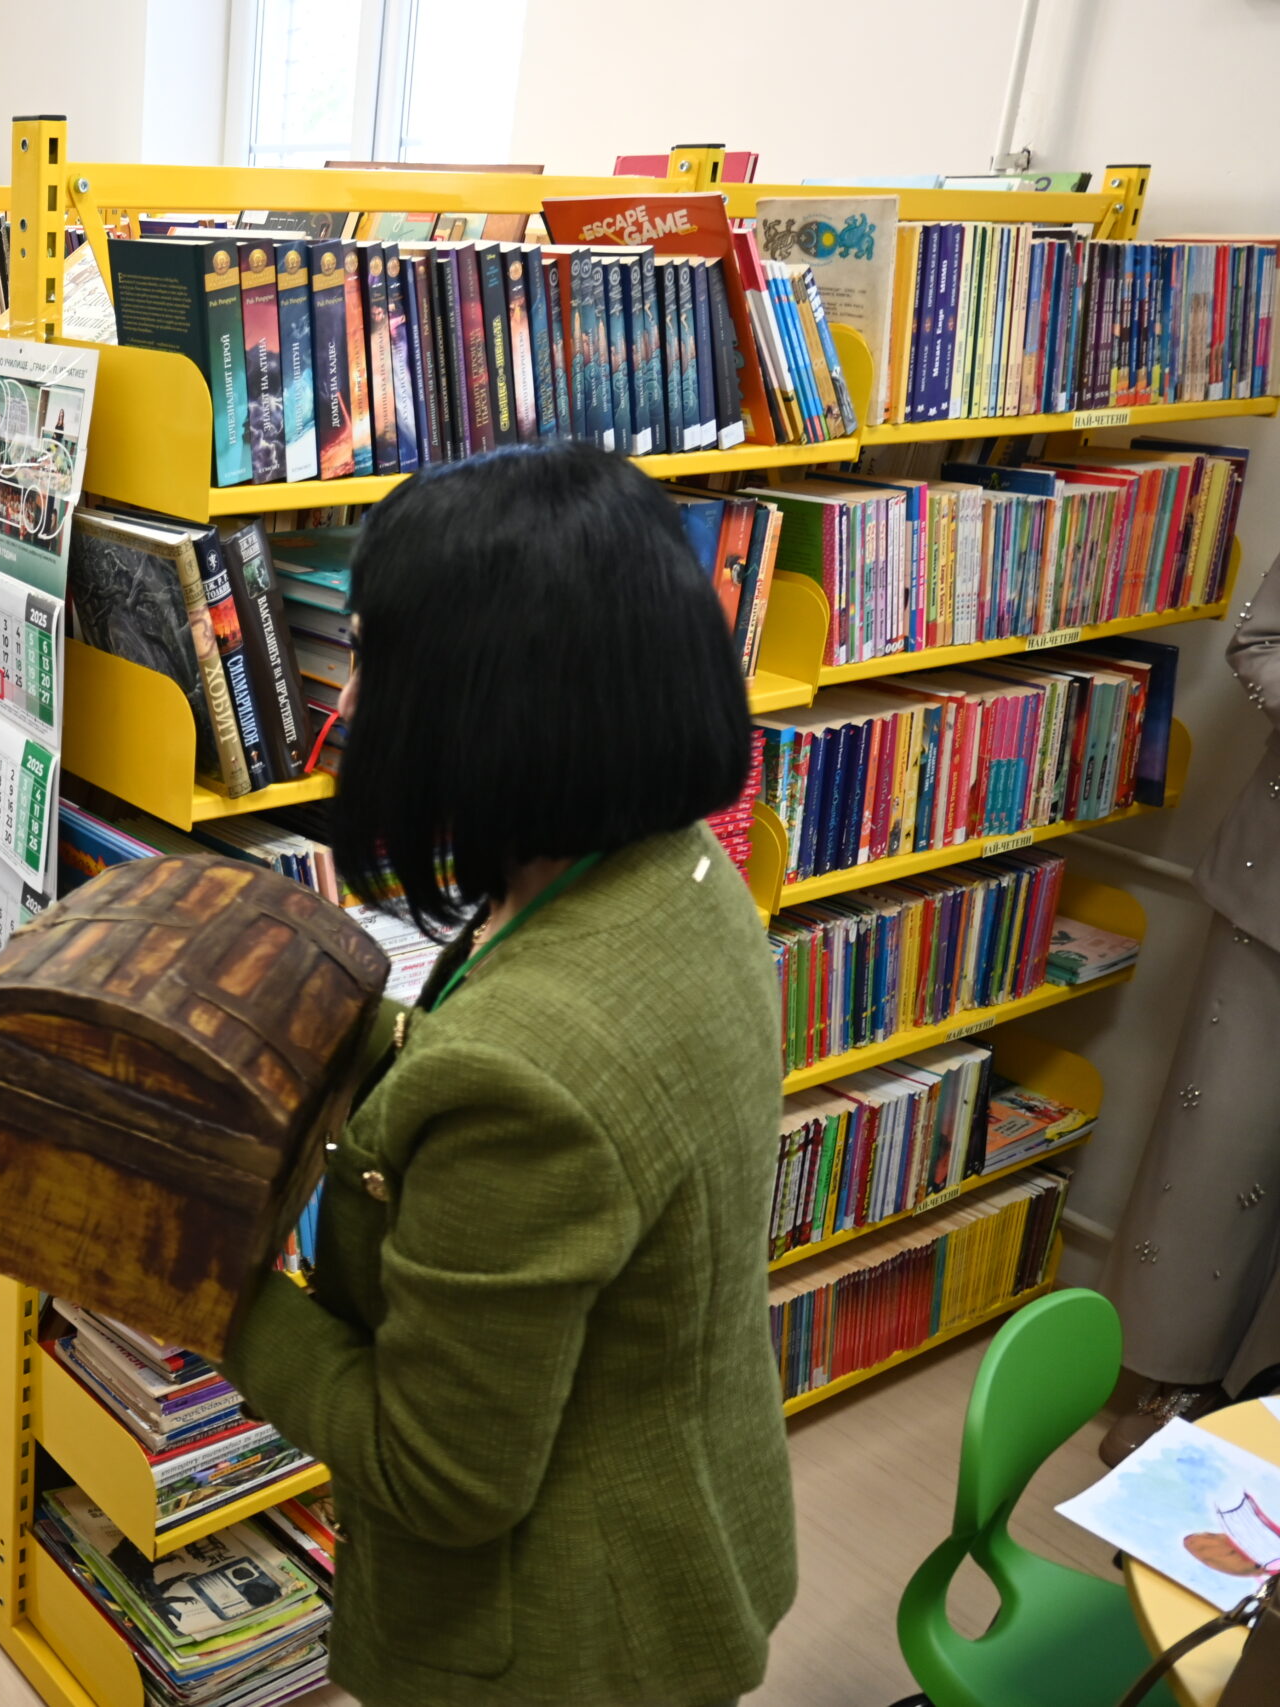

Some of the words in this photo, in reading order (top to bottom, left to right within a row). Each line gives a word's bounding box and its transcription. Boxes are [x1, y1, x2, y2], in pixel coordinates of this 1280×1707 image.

[582, 205, 648, 241] ESCAPE
[624, 208, 692, 246] GAME
[940, 260, 948, 294] МОМО
[936, 308, 944, 334] Енде
[3, 358, 28, 370] УЧИЛИЩЕ
[220, 334, 232, 370] ГЕРОЙ
[258, 337, 269, 374] АТИНА
[328, 341, 338, 376] ХАДЕС
[932, 339, 942, 377] Михаел
[261, 375, 269, 394] НА
[330, 378, 338, 394] НА
[223, 371, 236, 445] ИЗЧЕЗНАЛИЯТ
[262, 396, 271, 432] ЗНАКЪТ
[331, 394, 340, 427] ДОМЪТ
[1074, 412, 1129, 428] НАЙ-ЧЕТЕНИ
[206, 584, 232, 600] ТОЛКИН
[30, 608, 48, 628] 2025
[258, 595, 280, 668] ВЛАСТЕЛИНЪТ
[2, 634, 9, 648] 10
[42, 656, 50, 671] 13
[4, 618, 8, 631] 3
[16, 626, 20, 638] 4
[42, 640, 48, 654] 6
[1028, 632, 1080, 650] НАЙ-ЧЕТЕНИ
[3, 650, 9, 664] 17
[41, 672, 50, 688] 20
[274, 664, 282, 680] НА
[16, 674, 22, 688] 25
[41, 688, 50, 705] 27
[204, 661, 238, 744] ХОБИТ
[226, 654, 260, 747] СИЛМАРИЛИОН
[275, 678, 297, 744] ПРЪСТЕНИТЕ
[26, 755, 44, 777] 2025
[9, 785, 14, 796] 9
[34, 804, 40, 818] 11
[11, 770, 15, 782] 2
[36, 789, 41, 801] 4
[8, 798, 14, 813] 16
[31, 820, 39, 834] 18
[4, 830, 12, 845] 30
[28, 836, 38, 851] 25
[946, 1018, 994, 1040] НАЙ-ЧЕТЕНИ
